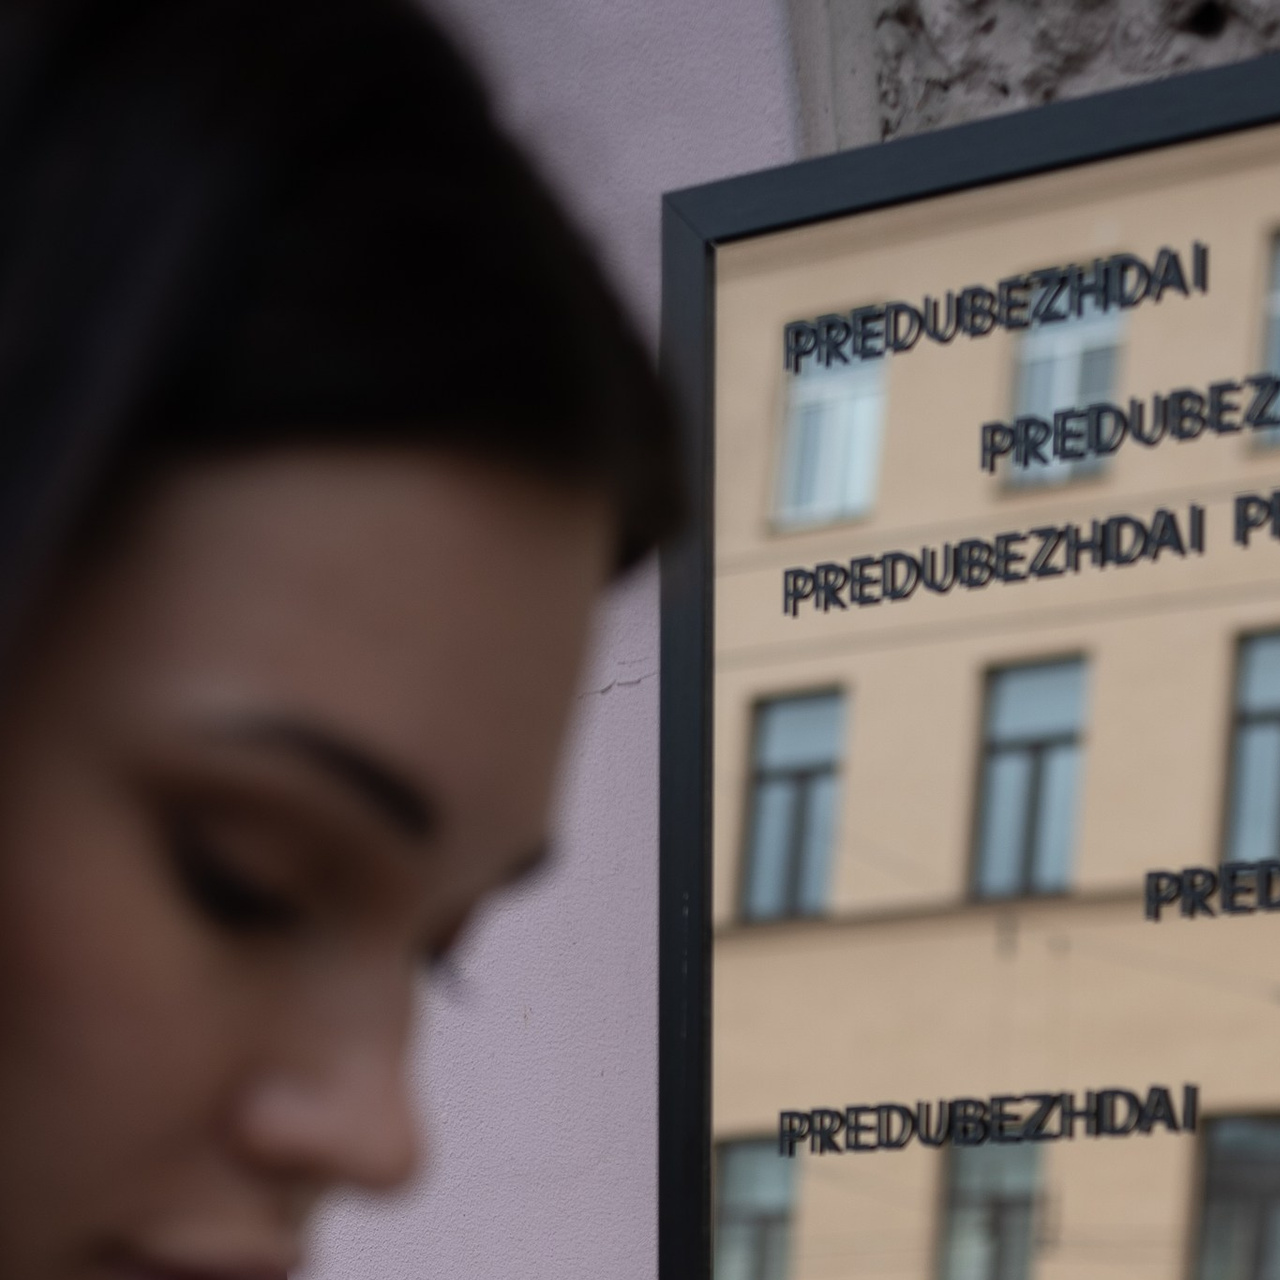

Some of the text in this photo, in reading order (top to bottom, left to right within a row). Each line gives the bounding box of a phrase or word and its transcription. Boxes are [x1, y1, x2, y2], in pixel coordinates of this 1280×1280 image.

[783, 242, 1209, 374] PREDUBEZHDAI
[783, 505, 1206, 617] PREDUBEZHDAI
[778, 1084, 1199, 1157] PREDUBEZHDAI
